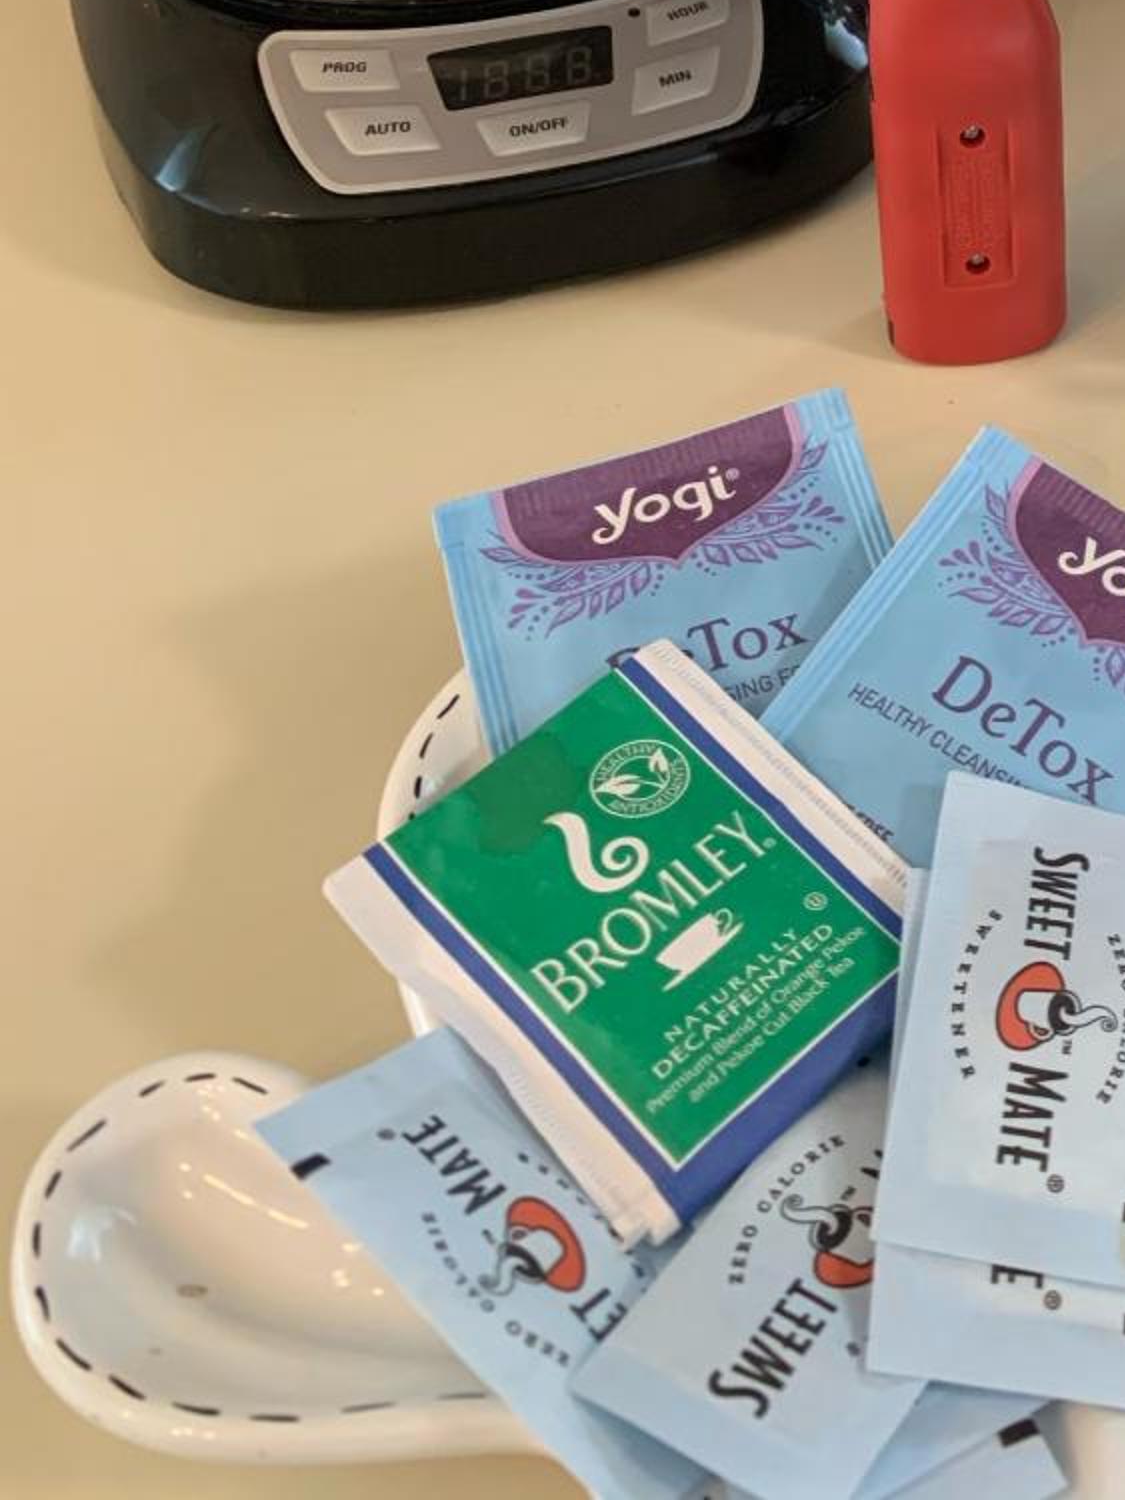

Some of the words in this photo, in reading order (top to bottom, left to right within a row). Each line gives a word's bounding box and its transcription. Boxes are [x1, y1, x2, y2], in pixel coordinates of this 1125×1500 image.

[666, 0, 711, 22] HOUR
[321, 59, 369, 75] PROG
[657, 68, 693, 90] MIN
[364, 119, 413, 137] AUTO
[508, 115, 569, 139] ON/OFF
[591, 464, 737, 546] yogi
[605, 612, 811, 674] Tox
[847, 682, 934, 738] HEALTHY
[930, 653, 1115, 806] DeTox
[530, 809, 766, 1014] BROMLEY
[1023, 845, 1091, 962] SWEET
[651, 924, 833, 1080] DECAFFEINATED
[664, 928, 798, 1043] NATURALLY
[762, 1011, 792, 1036] Cut
[950, 908, 1003, 1079] SWEETENER
[995, 1061, 1070, 1174] MATE
[401, 1114, 508, 1217] MATE
[727, 1223, 759, 1286] ZERO
[756, 1134, 847, 1215] CALORIE
[504, 1318, 572, 1368] ZERO
[707, 1277, 839, 1421] SWEET
